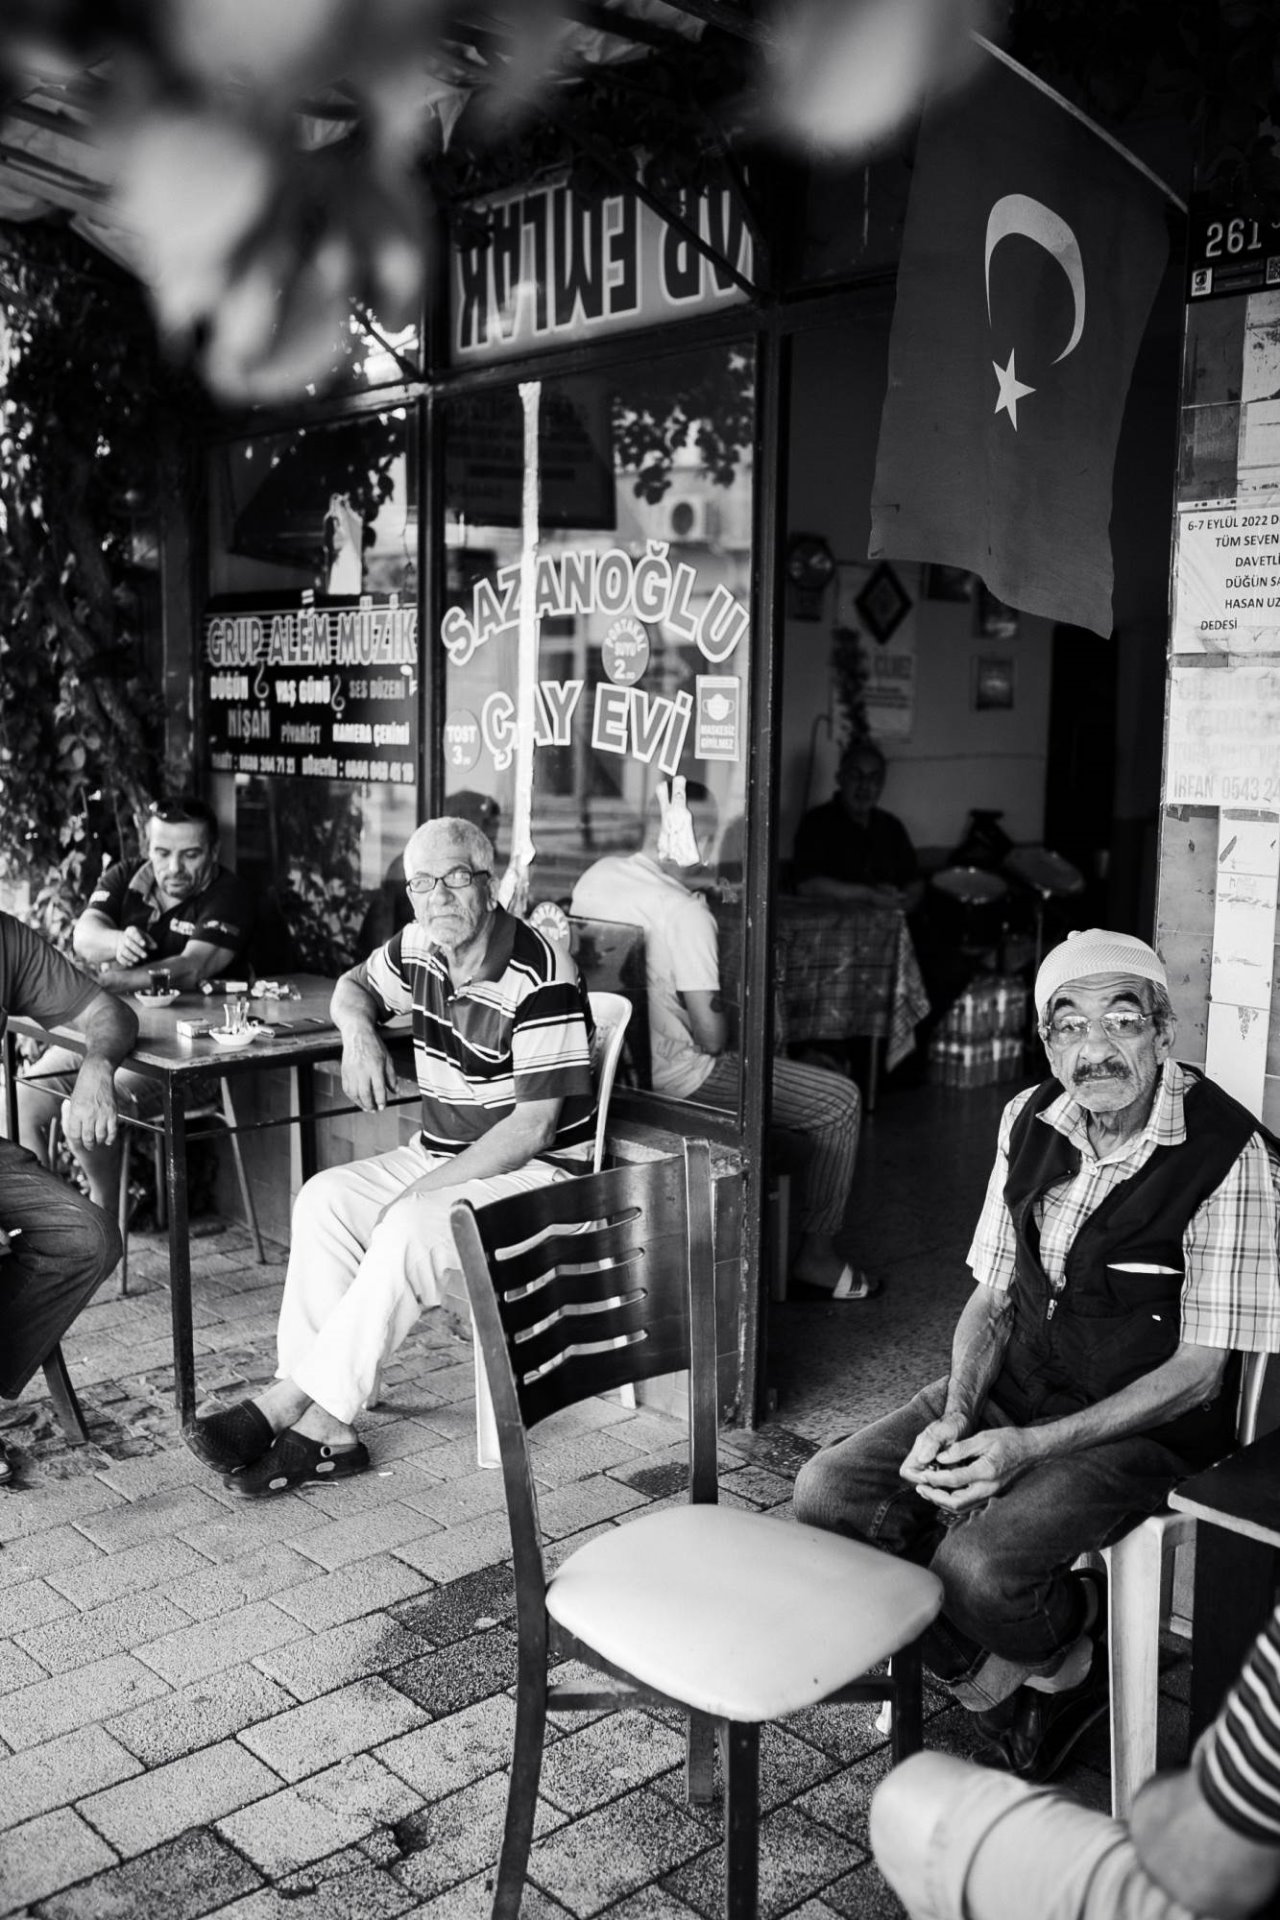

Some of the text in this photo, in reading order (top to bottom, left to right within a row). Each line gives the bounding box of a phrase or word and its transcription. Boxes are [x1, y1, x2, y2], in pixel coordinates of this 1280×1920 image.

[1206, 218, 1262, 258] 261
[457, 186, 641, 352] EMLAK
[1187, 520, 1204, 531] 6-7
[1207, 516, 1238, 530] EYLÜL
[1242, 515, 1268, 527] 2022
[1215, 533, 1280, 548] TÜM SEVEN
[1225, 574, 1267, 588] DÜĞÜN
[441, 539, 750, 666] SAZANOĞLU
[1225, 598, 1263, 609] HASAN
[208, 616, 262, 667] GRUP
[336, 592, 418, 665] MÜZİK
[604, 618, 647, 652] PORTAKAL
[1200, 617, 1237, 631] DEDESİ
[614, 642, 637, 657] SUYU
[349, 674, 406, 700] SES DÜZENİ
[228, 703, 271, 743] NİŞAN
[446, 725, 477, 744] TOST
[481, 680, 694, 776] ÇAY EVİ
[1173, 771, 1214, 799] İRFAN
[1222, 776, 1260, 801] 0543
